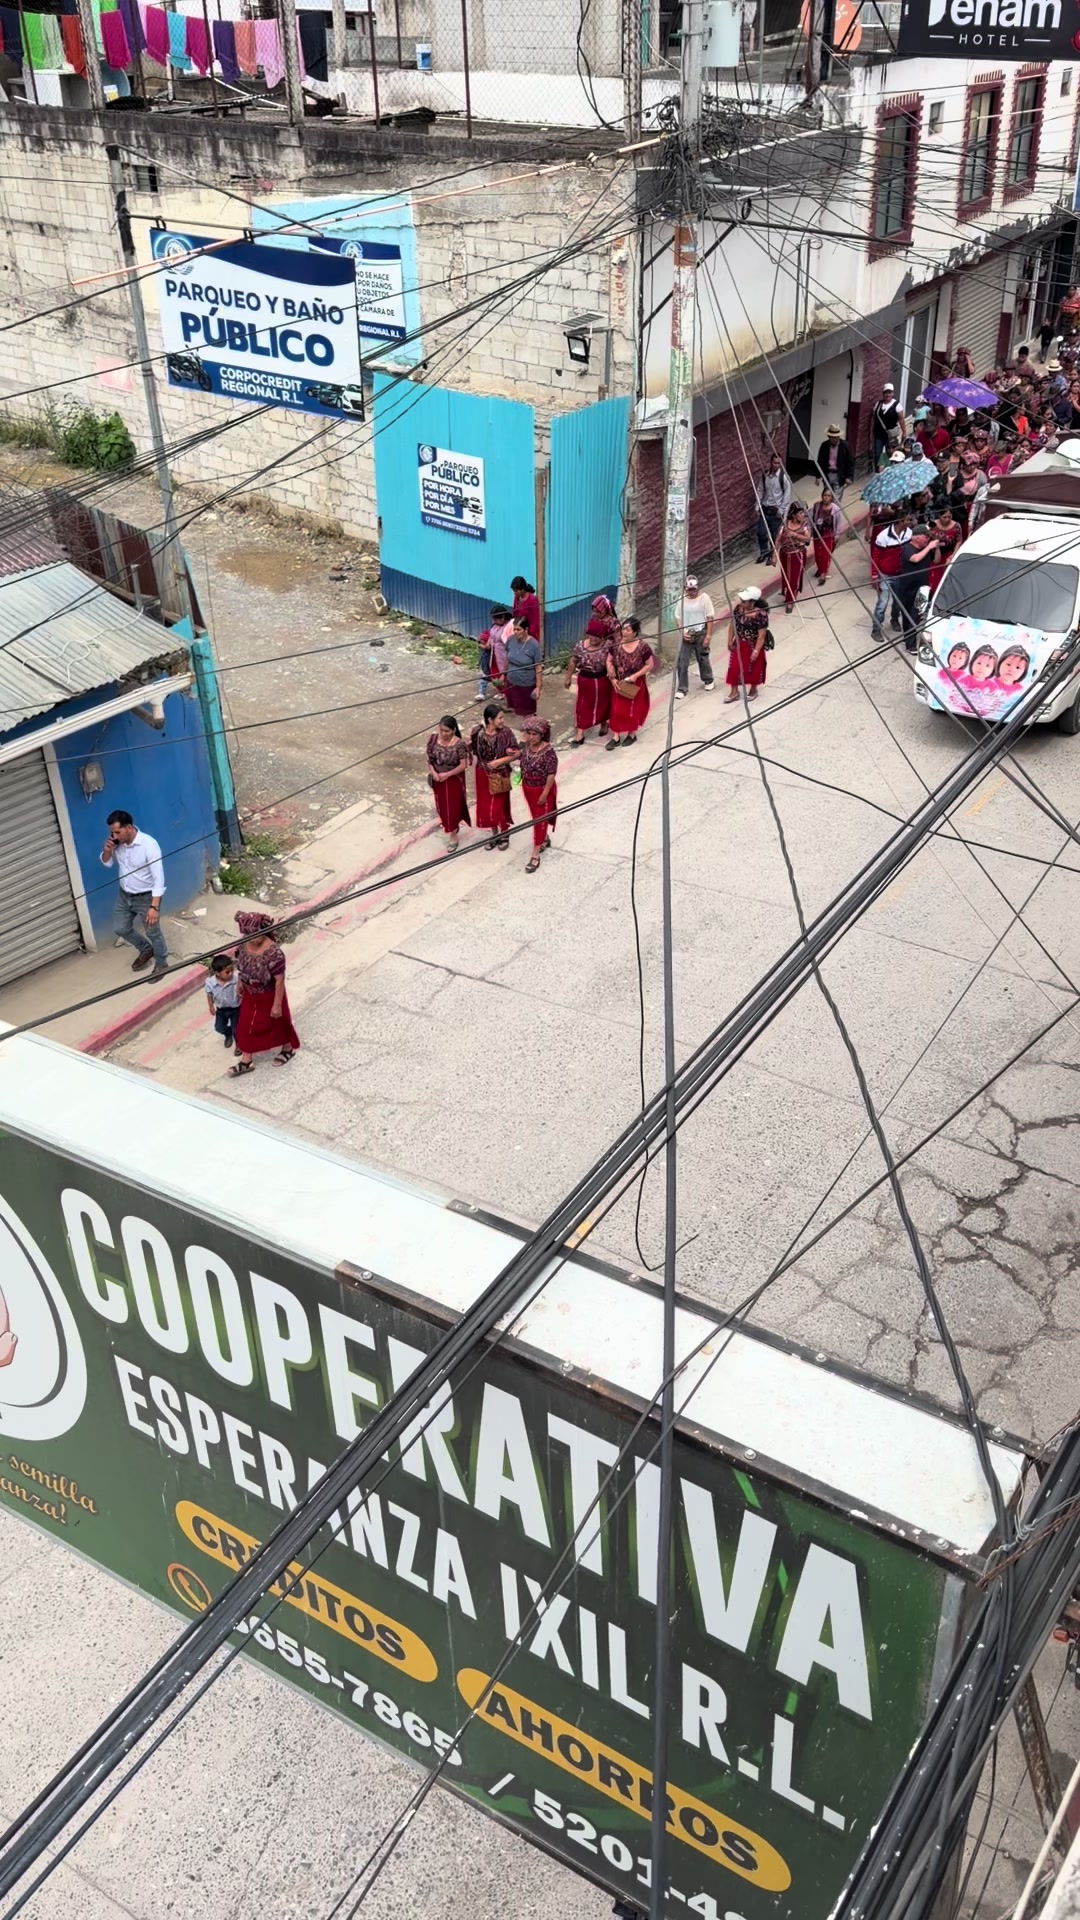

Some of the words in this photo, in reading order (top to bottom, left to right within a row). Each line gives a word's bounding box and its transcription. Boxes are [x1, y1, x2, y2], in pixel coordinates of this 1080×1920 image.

[958, 33, 1019, 47] HOTEL
[358, 279, 370, 288] POR
[165, 279, 260, 312] PARQUEO
[264, 294, 279, 314] Y
[283, 297, 344, 325] BAÑO
[181, 308, 335, 367] PÚBLICO
[219, 367, 303, 391] CORPOCREDIT
[221, 381, 281, 401] REGIONAL
[282, 391, 304, 405] R.L.
[431, 464, 480, 487] PÚBLICO
[444, 460, 479, 476] PARQUEO
[423, 480, 439, 491] POR
[439, 484, 462, 497] HORA
[424, 490, 439, 500] POR
[439, 493, 454, 505] DÍA
[425, 500, 440, 510] POR
[440, 504, 456, 515] MES
[60, 1187, 873, 1721] COOPERATIVA
[8, 1455, 97, 1514] semilla
[192, 1515, 407, 1661] CRDITOS
[486, 1688, 761, 1871] AHORROS
[499, 1562, 651, 1720] IXIL
[681, 1661, 846, 1830] R.L.
[533, 1786, 750, 1920] 5201-4
